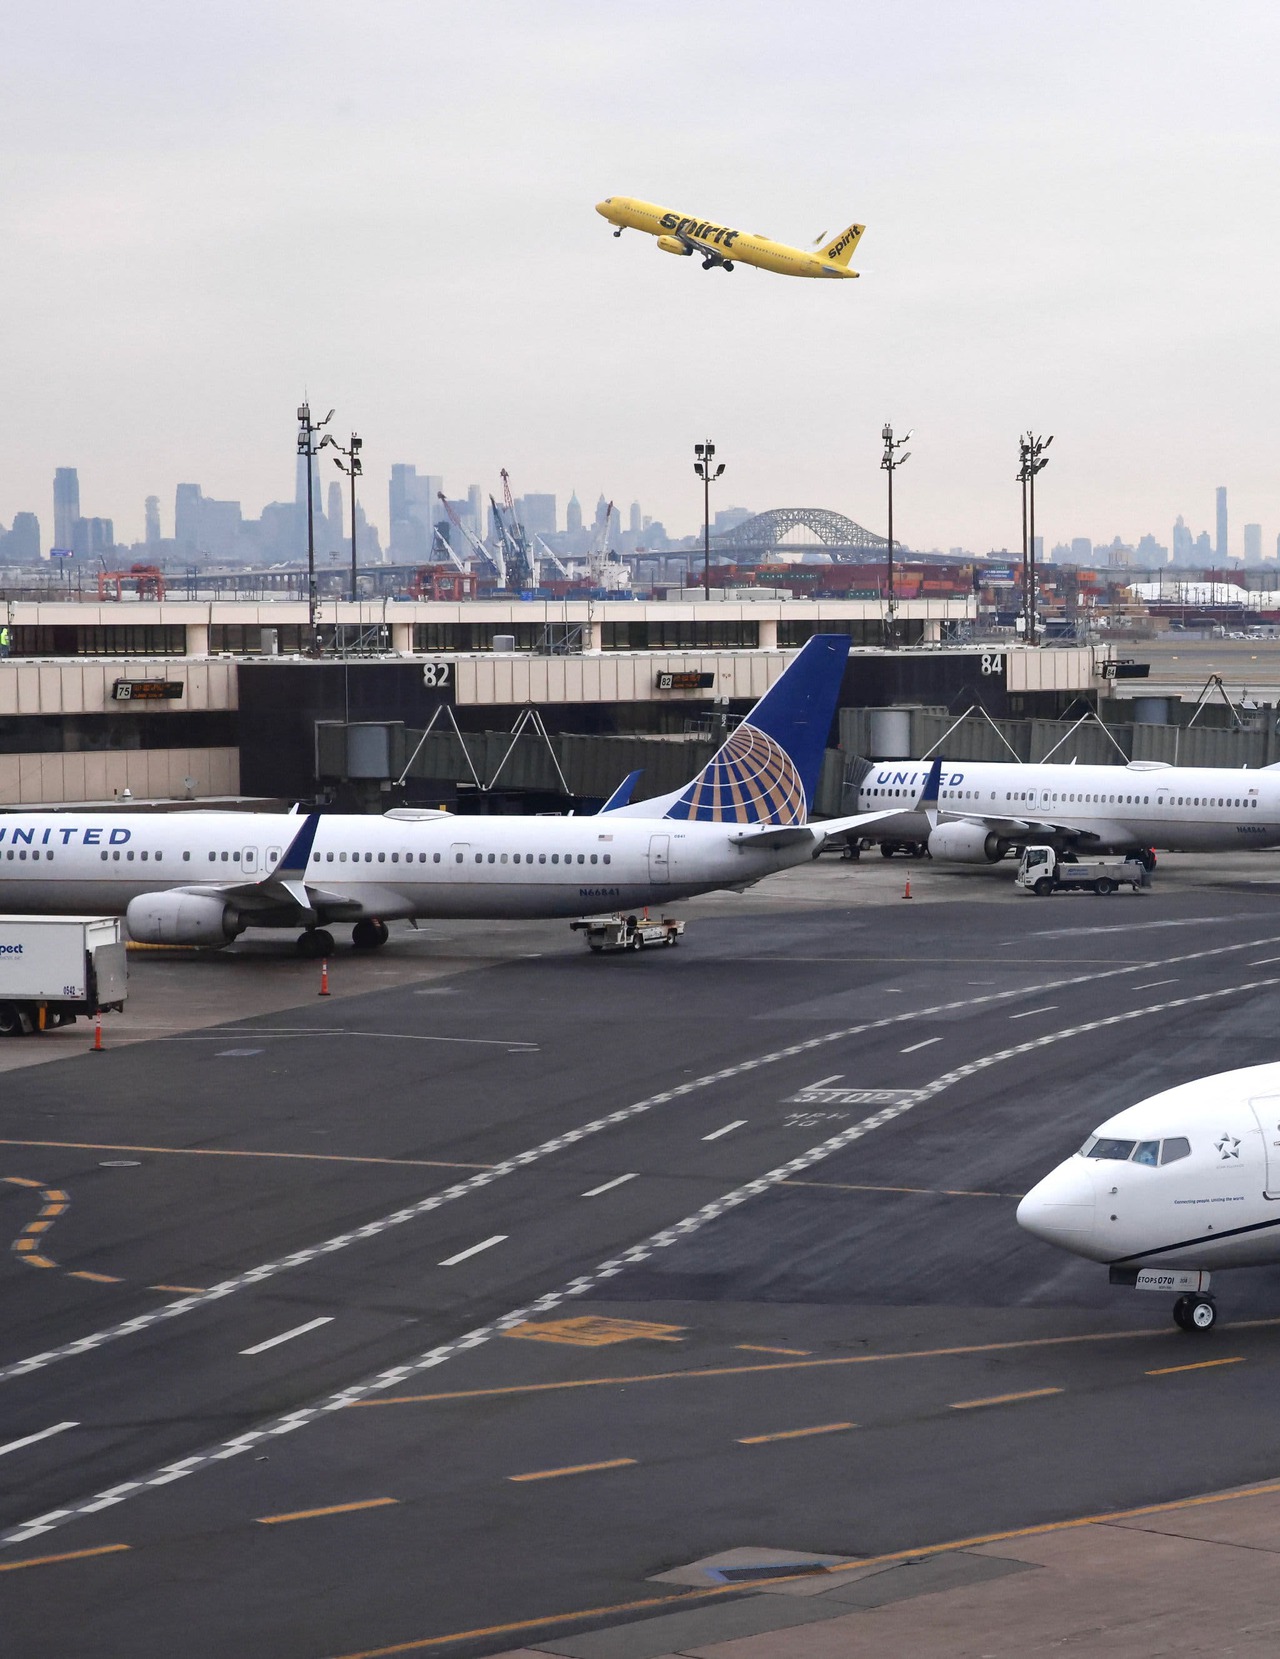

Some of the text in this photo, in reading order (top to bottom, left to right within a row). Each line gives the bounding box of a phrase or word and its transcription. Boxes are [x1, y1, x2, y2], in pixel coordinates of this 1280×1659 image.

[660, 213, 739, 248] spirit
[828, 225, 860, 259] spirit
[981, 653, 1002, 675] 84
[423, 663, 450, 687] 82
[661, 677, 671, 686] 82
[119, 687, 130, 696] 75
[877, 771, 965, 786] UNITED
[0, 828, 132, 845] NITED
[579, 888, 620, 897] N66841
[63, 986, 76, 995] 0542
[794, 1092, 896, 1103] STOP
[1137, 1276, 1157, 1284] ETOPS
